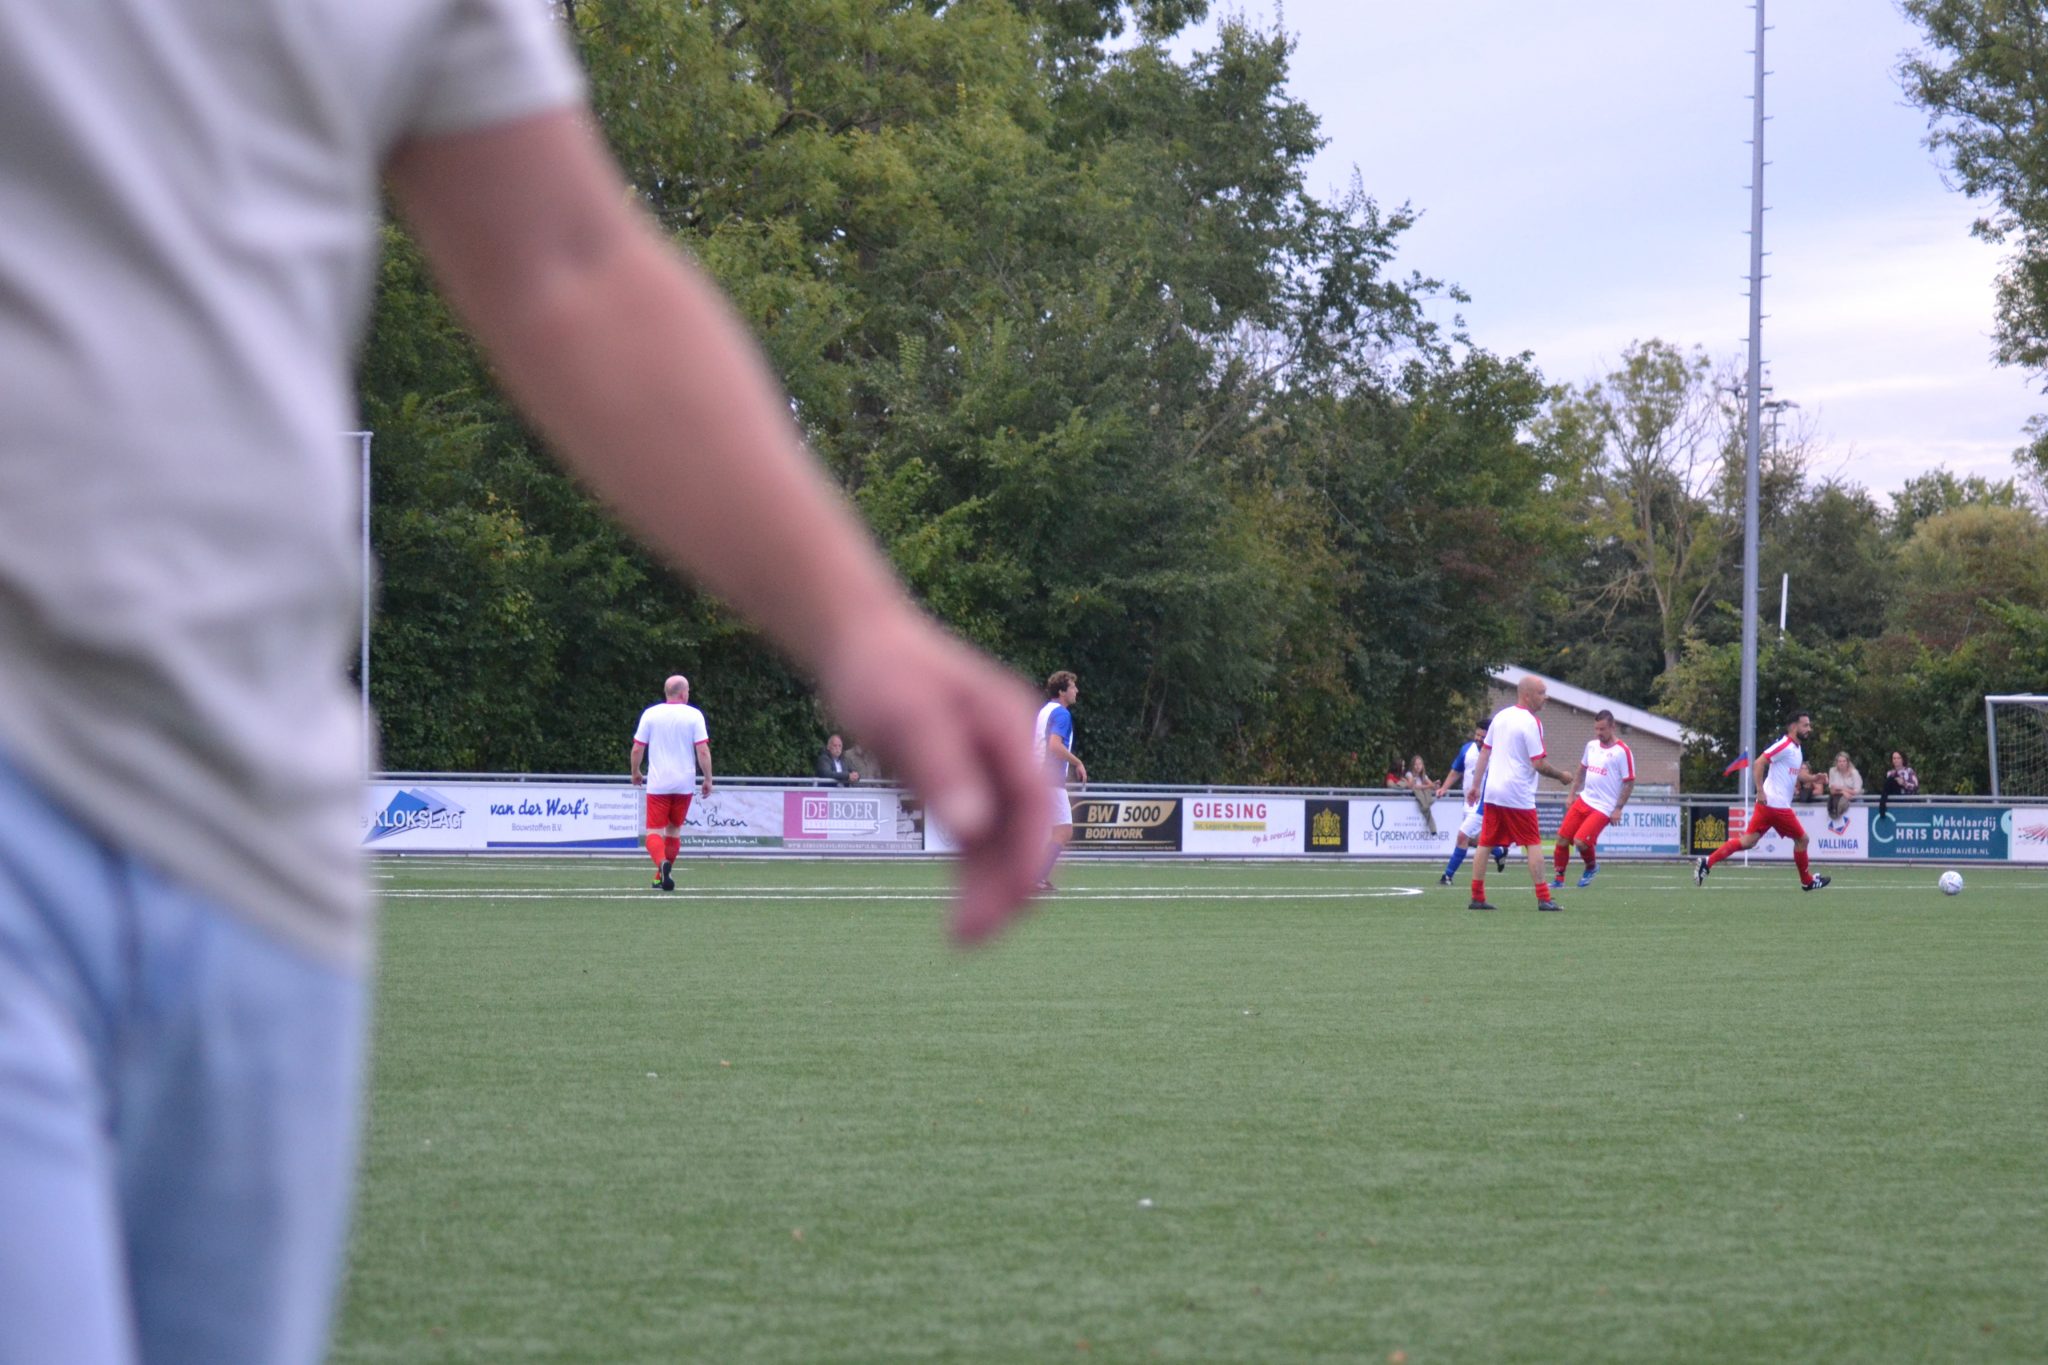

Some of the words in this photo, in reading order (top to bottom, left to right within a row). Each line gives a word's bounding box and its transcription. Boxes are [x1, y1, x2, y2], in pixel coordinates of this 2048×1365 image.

[490, 803, 515, 816] van
[518, 798, 543, 816] der
[546, 797, 589, 820] Werf's
[806, 802, 827, 819] DE
[833, 802, 874, 819] BOER
[1087, 805, 1114, 823] BW
[1123, 806, 1161, 822] 5000
[1193, 803, 1267, 819] GIESING
[374, 810, 463, 830] KLOKSLAG
[511, 823, 551, 832] Bouwstoffen
[707, 813, 748, 828] Buren
[1634, 813, 1677, 828] TECHNIEK
[1932, 815, 1997, 831] Makelaardij
[1085, 828, 1143, 839] BODYWORK
[1363, 831, 1374, 841] DE
[1933, 829, 1990, 841] DRAIJER
[1818, 838, 1859, 849] VALLINGA
